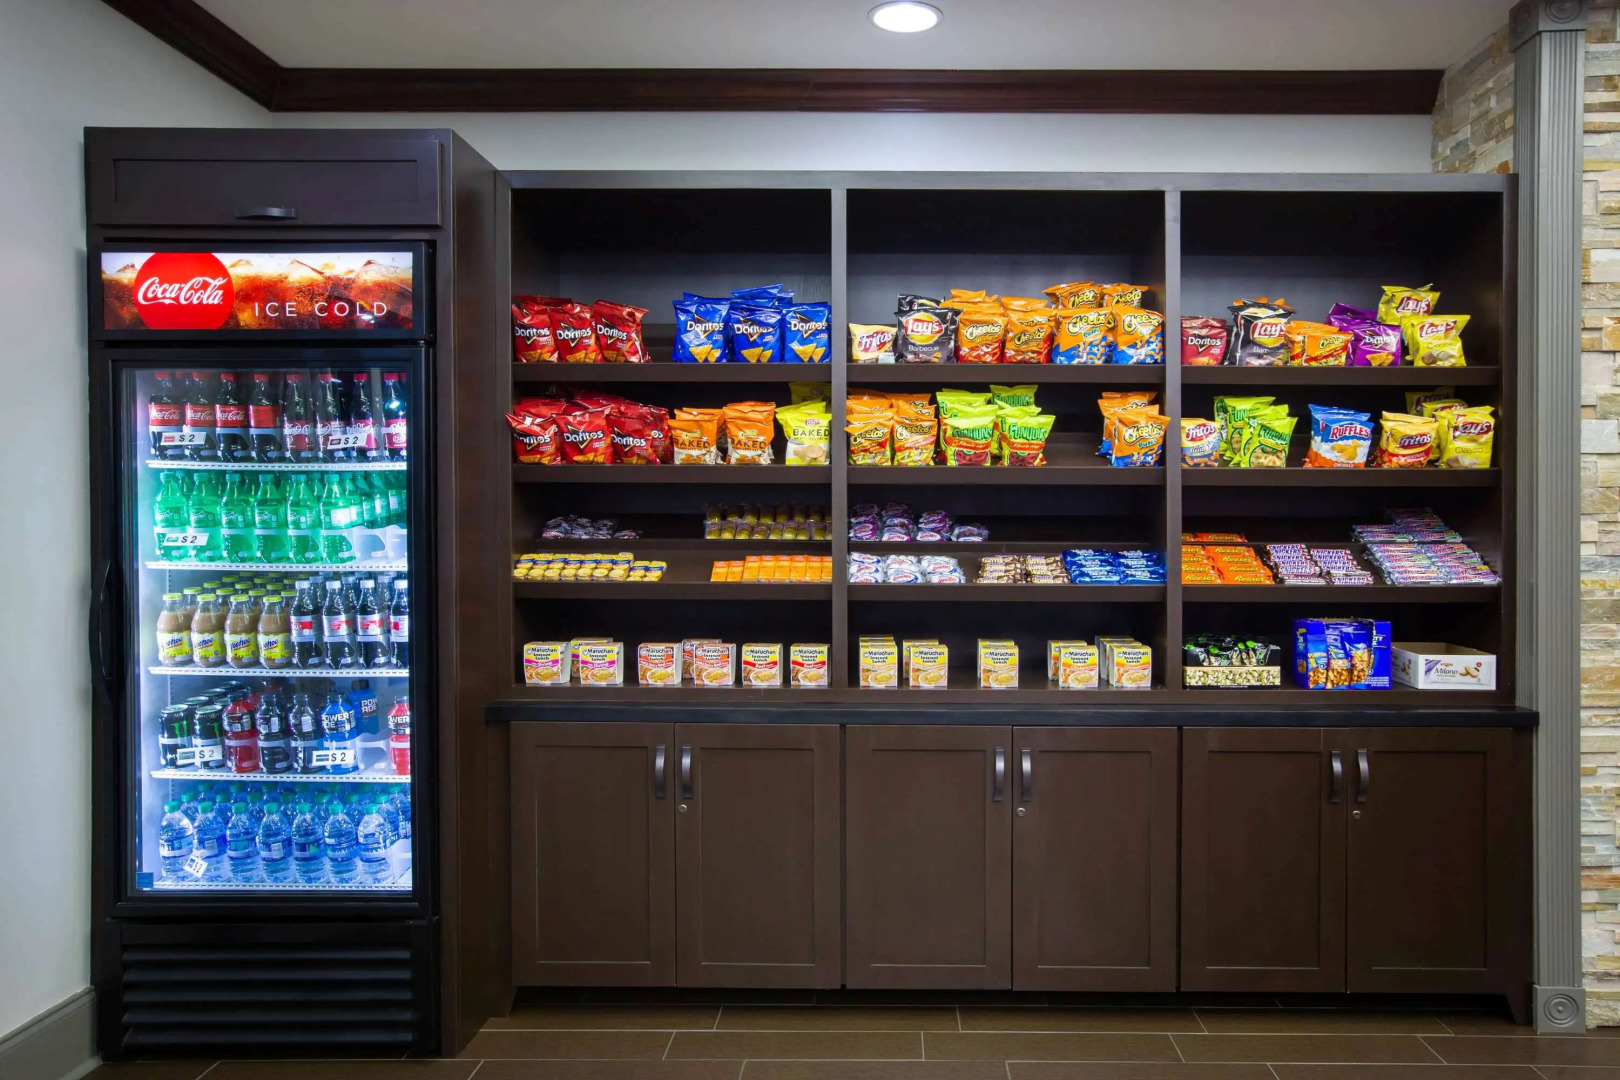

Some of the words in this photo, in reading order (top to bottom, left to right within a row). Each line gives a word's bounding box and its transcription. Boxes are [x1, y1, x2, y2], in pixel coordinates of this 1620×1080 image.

[138, 276, 229, 305] Coca-Cola
[254, 302, 298, 317] ICE
[314, 302, 387, 317] COLD
[1398, 297, 1430, 312] Lay's
[686, 321, 724, 331] Doritos
[790, 320, 828, 331] Doritos
[907, 318, 940, 335] Lay's
[1123, 313, 1161, 333] Cheeos
[1422, 320, 1457, 337] Lay's
[515, 327, 550, 337] Doritos
[556, 327, 592, 340] Doritos
[596, 324, 627, 340] Doritos
[966, 323, 1003, 341] Cheetos
[859, 331, 893, 350] Fritos
[1188, 337, 1222, 346] Doritos
[563, 430, 604, 443] Doritos
[793, 428, 830, 437] BAKED
[1123, 422, 1163, 445] Cheetos
[1186, 423, 1216, 438] Fritos
[1329, 425, 1371, 440] RUFFLES
[611, 433, 647, 447] Doritos
[674, 438, 710, 449] BAKED
[731, 438, 767, 449] BAKED
[1400, 433, 1432, 448] Fritos
